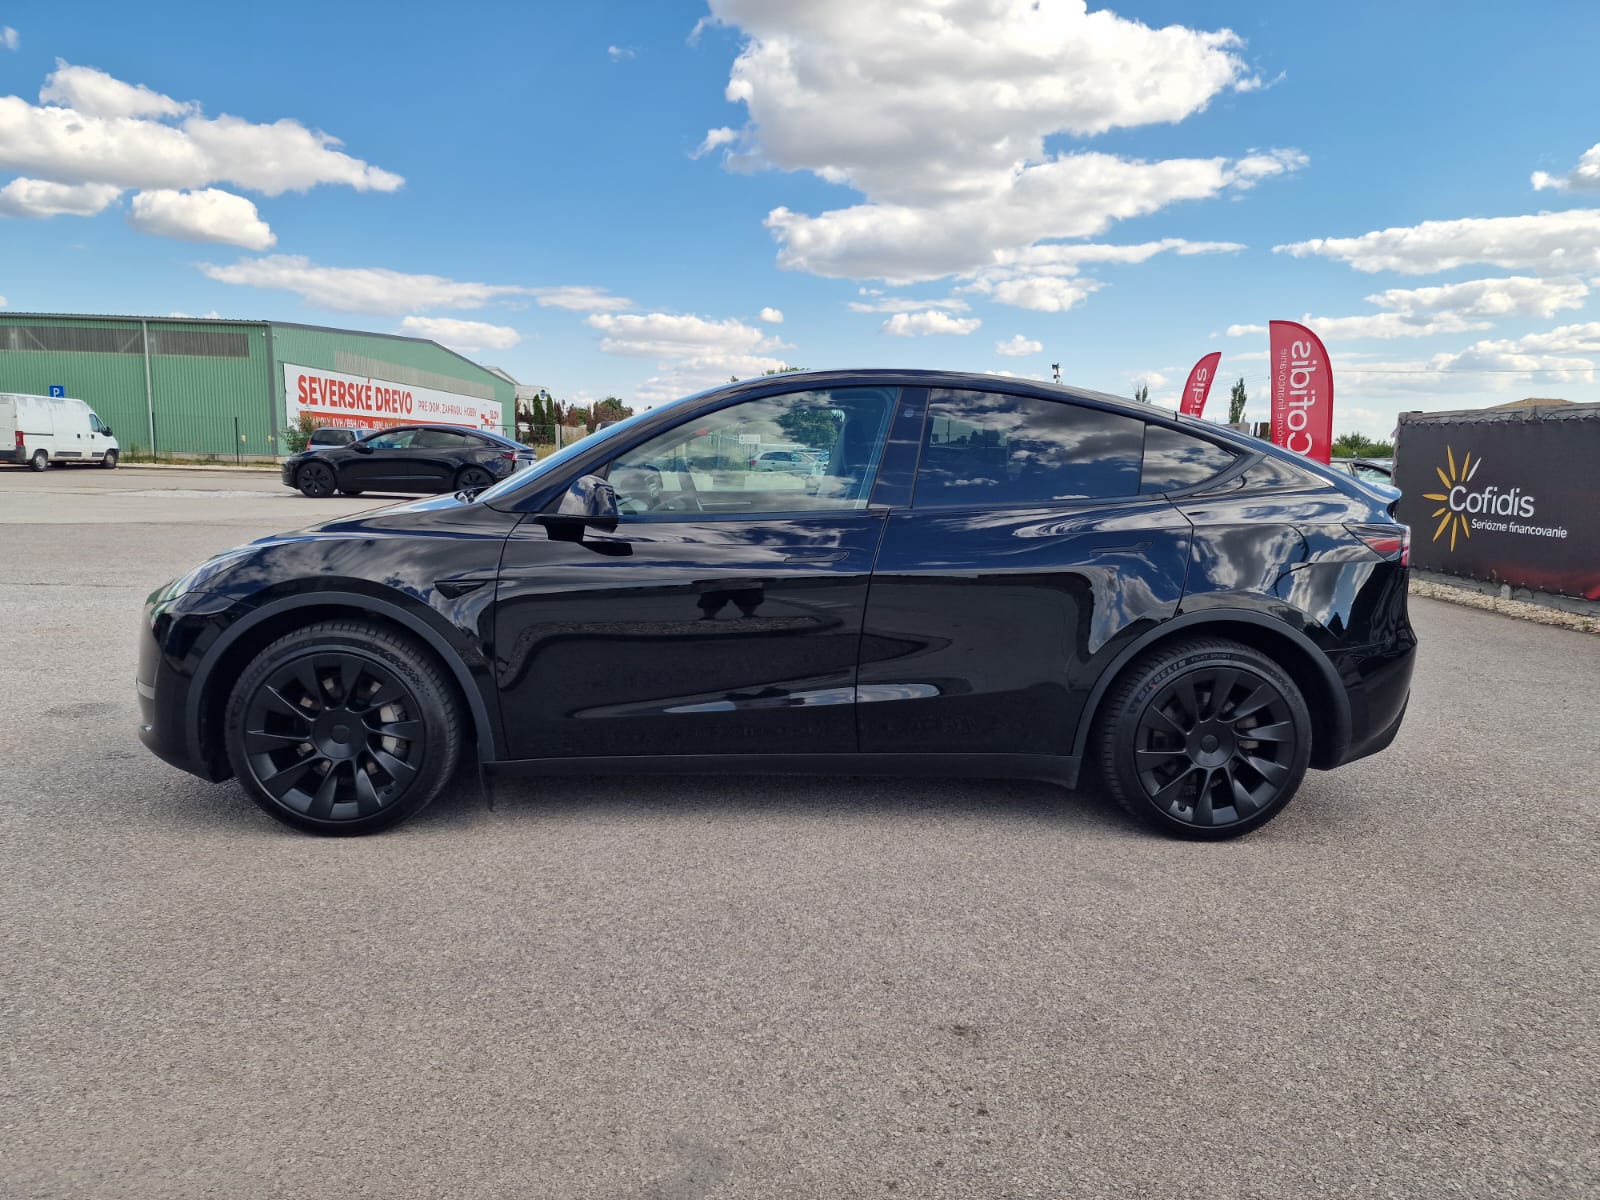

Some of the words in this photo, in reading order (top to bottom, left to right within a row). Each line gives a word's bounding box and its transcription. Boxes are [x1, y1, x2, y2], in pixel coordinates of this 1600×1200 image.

[53, 387, 60, 397] P
[298, 374, 372, 411] SEVERSKÉ
[375, 386, 412, 414] DREVO
[1189, 368, 1209, 417] fidis
[1450, 485, 1535, 517] Cofidis
[1471, 518, 1507, 531] Seriózne
[1509, 522, 1567, 539] financovanie
[1138, 659, 1186, 701] MICHELIN
